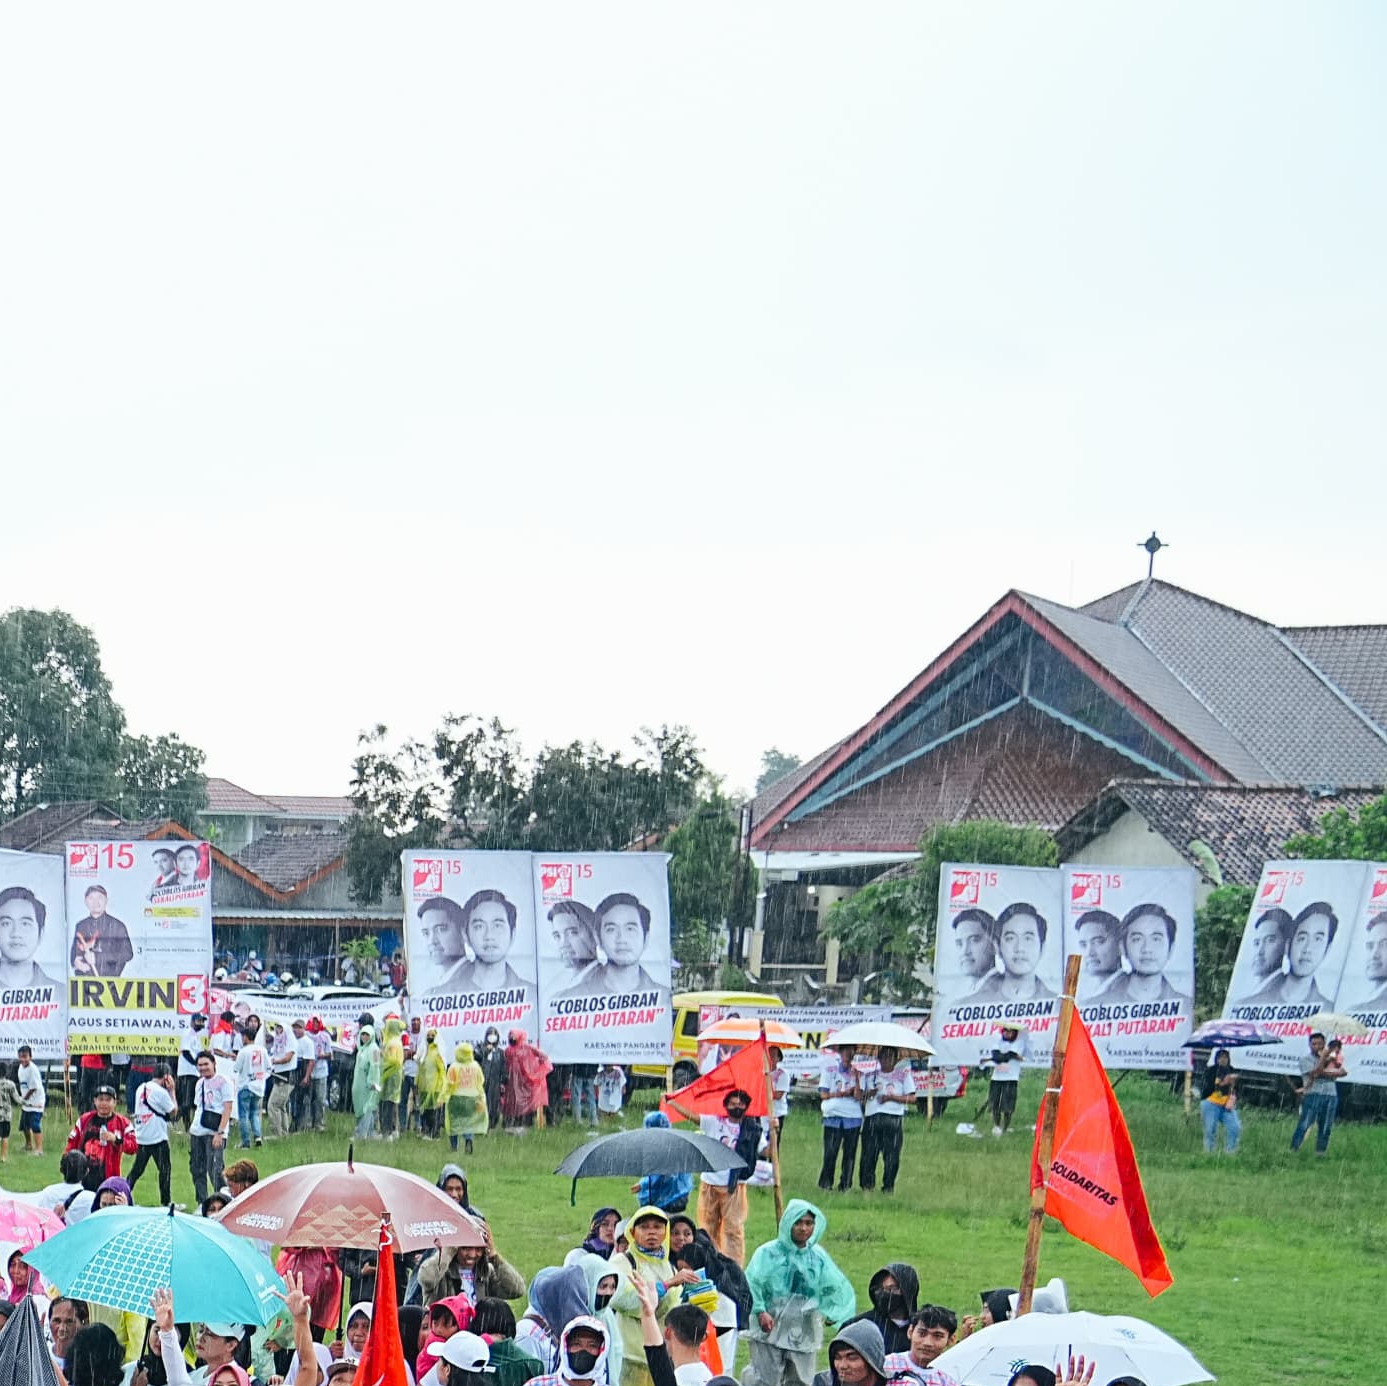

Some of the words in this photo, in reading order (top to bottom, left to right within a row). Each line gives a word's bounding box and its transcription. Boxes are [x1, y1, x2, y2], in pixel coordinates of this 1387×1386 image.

[102, 843, 134, 870] 15
[446, 860, 461, 875] 15
[577, 864, 592, 878] 15
[984, 872, 998, 887] 15
[1106, 874, 1121, 889] 15
[1291, 872, 1305, 886] 15
[2, 987, 53, 1004] GIBRAN
[70, 979, 175, 1009] IRVIN
[181, 978, 206, 1014] 3
[477, 988, 525, 1007] GIBRAN
[607, 992, 659, 1011] GIBRAN
[1005, 1000, 1054, 1017] GIBRAN
[1131, 1001, 1180, 1020] GIBRAN
[68, 1016, 102, 1028] AGUS
[105, 1017, 176, 1030] SETIAWAN,
[545, 1014, 588, 1033] SEKALI
[941, 1022, 986, 1039] SEKALI
[1107, 1050, 1143, 1058] KAESANG
[1050, 1161, 1118, 1206] SOLIDARITAS
[410, 1228, 452, 1238] PATRA
